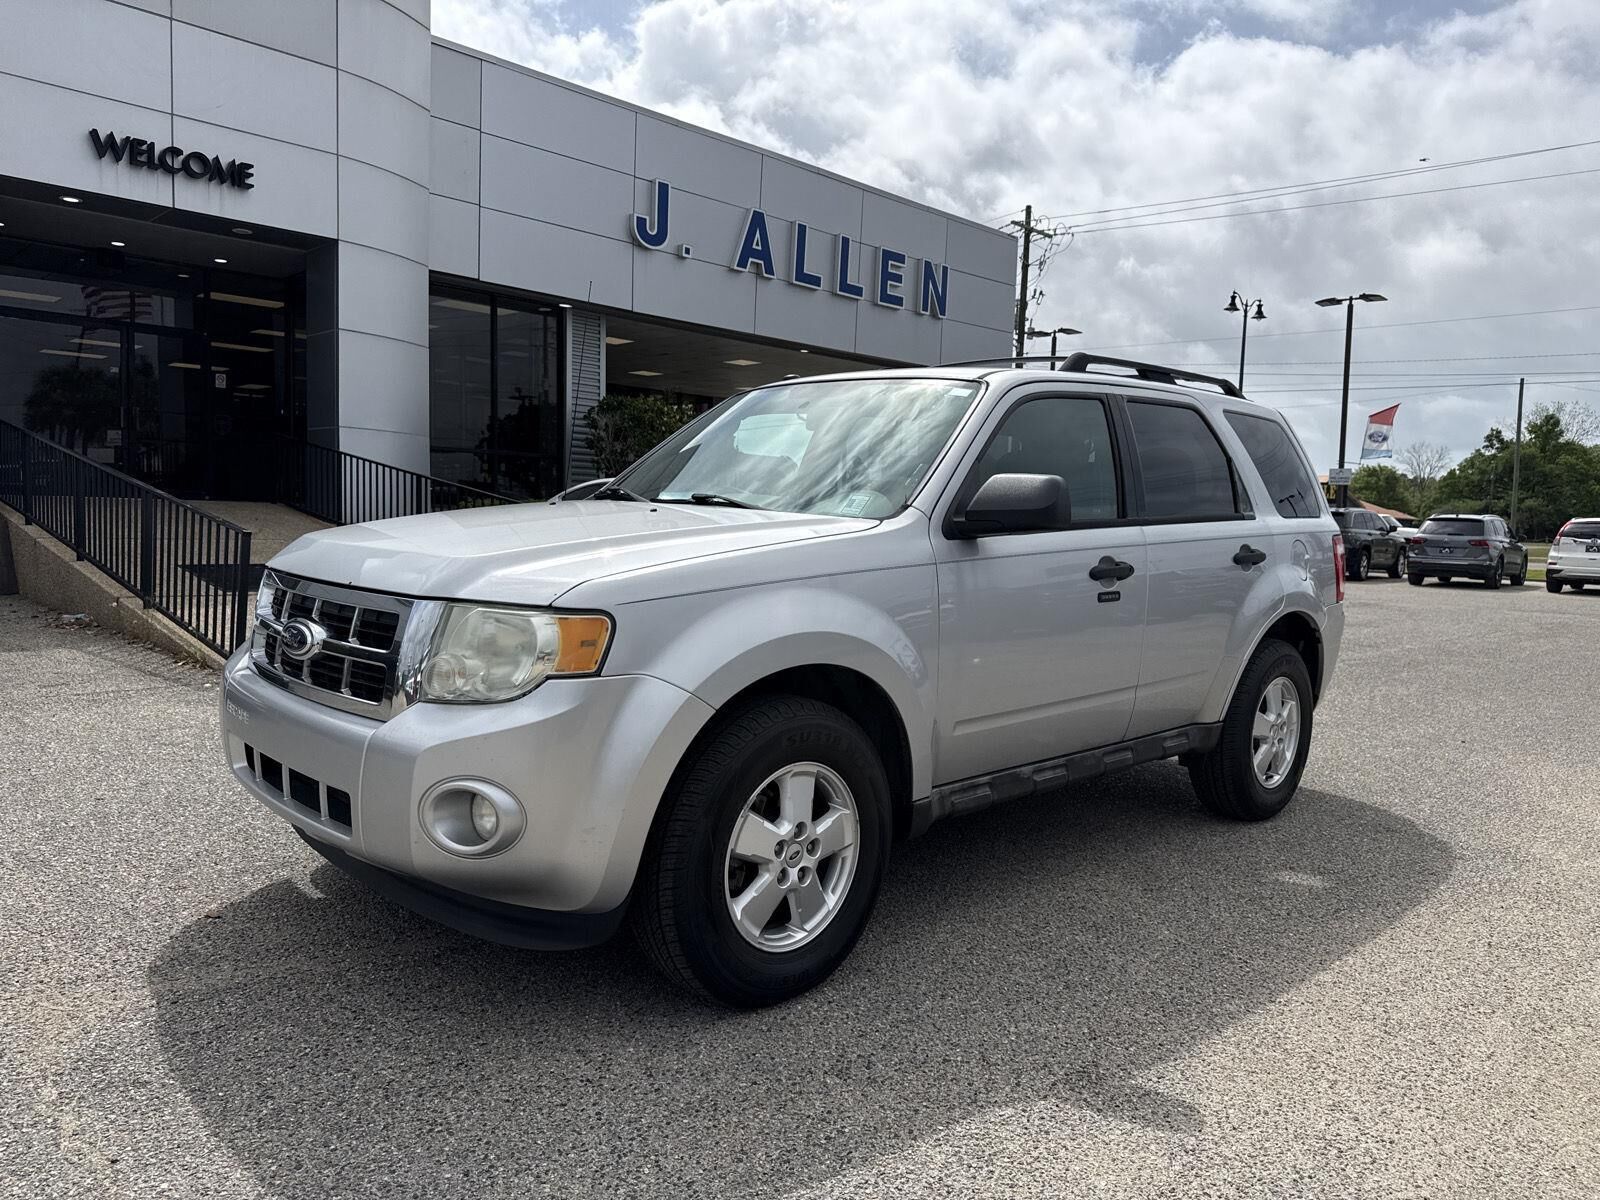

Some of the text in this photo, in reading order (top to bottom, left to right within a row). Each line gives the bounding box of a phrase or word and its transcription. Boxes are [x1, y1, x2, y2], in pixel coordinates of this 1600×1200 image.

[88, 128, 255, 189] WELCOME
[631, 178, 948, 318] J. ALLEN
